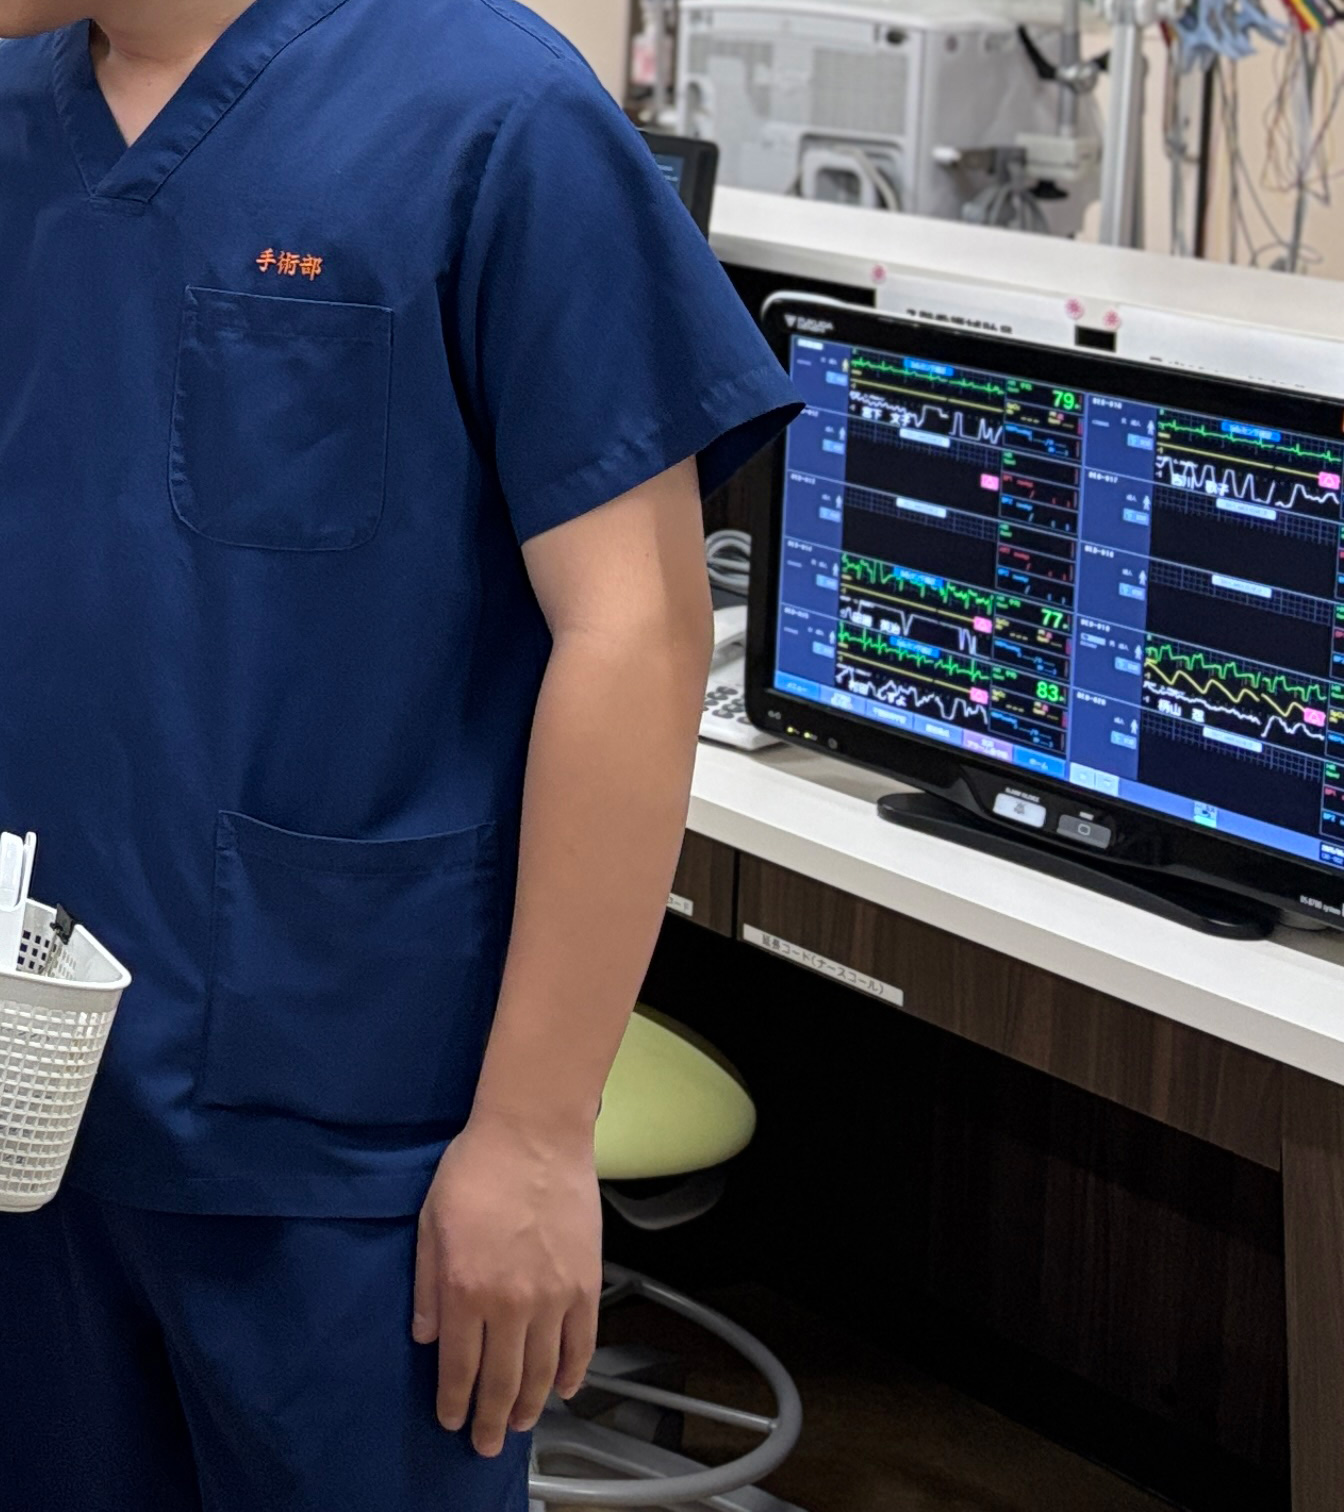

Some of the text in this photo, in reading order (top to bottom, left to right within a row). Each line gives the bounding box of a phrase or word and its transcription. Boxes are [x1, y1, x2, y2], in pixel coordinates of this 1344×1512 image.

[255, 246, 324, 282] 手術部
[1052, 390, 1075, 411] 79
[1040, 608, 1064, 629] 77
[1036, 681, 1060, 702] 83
